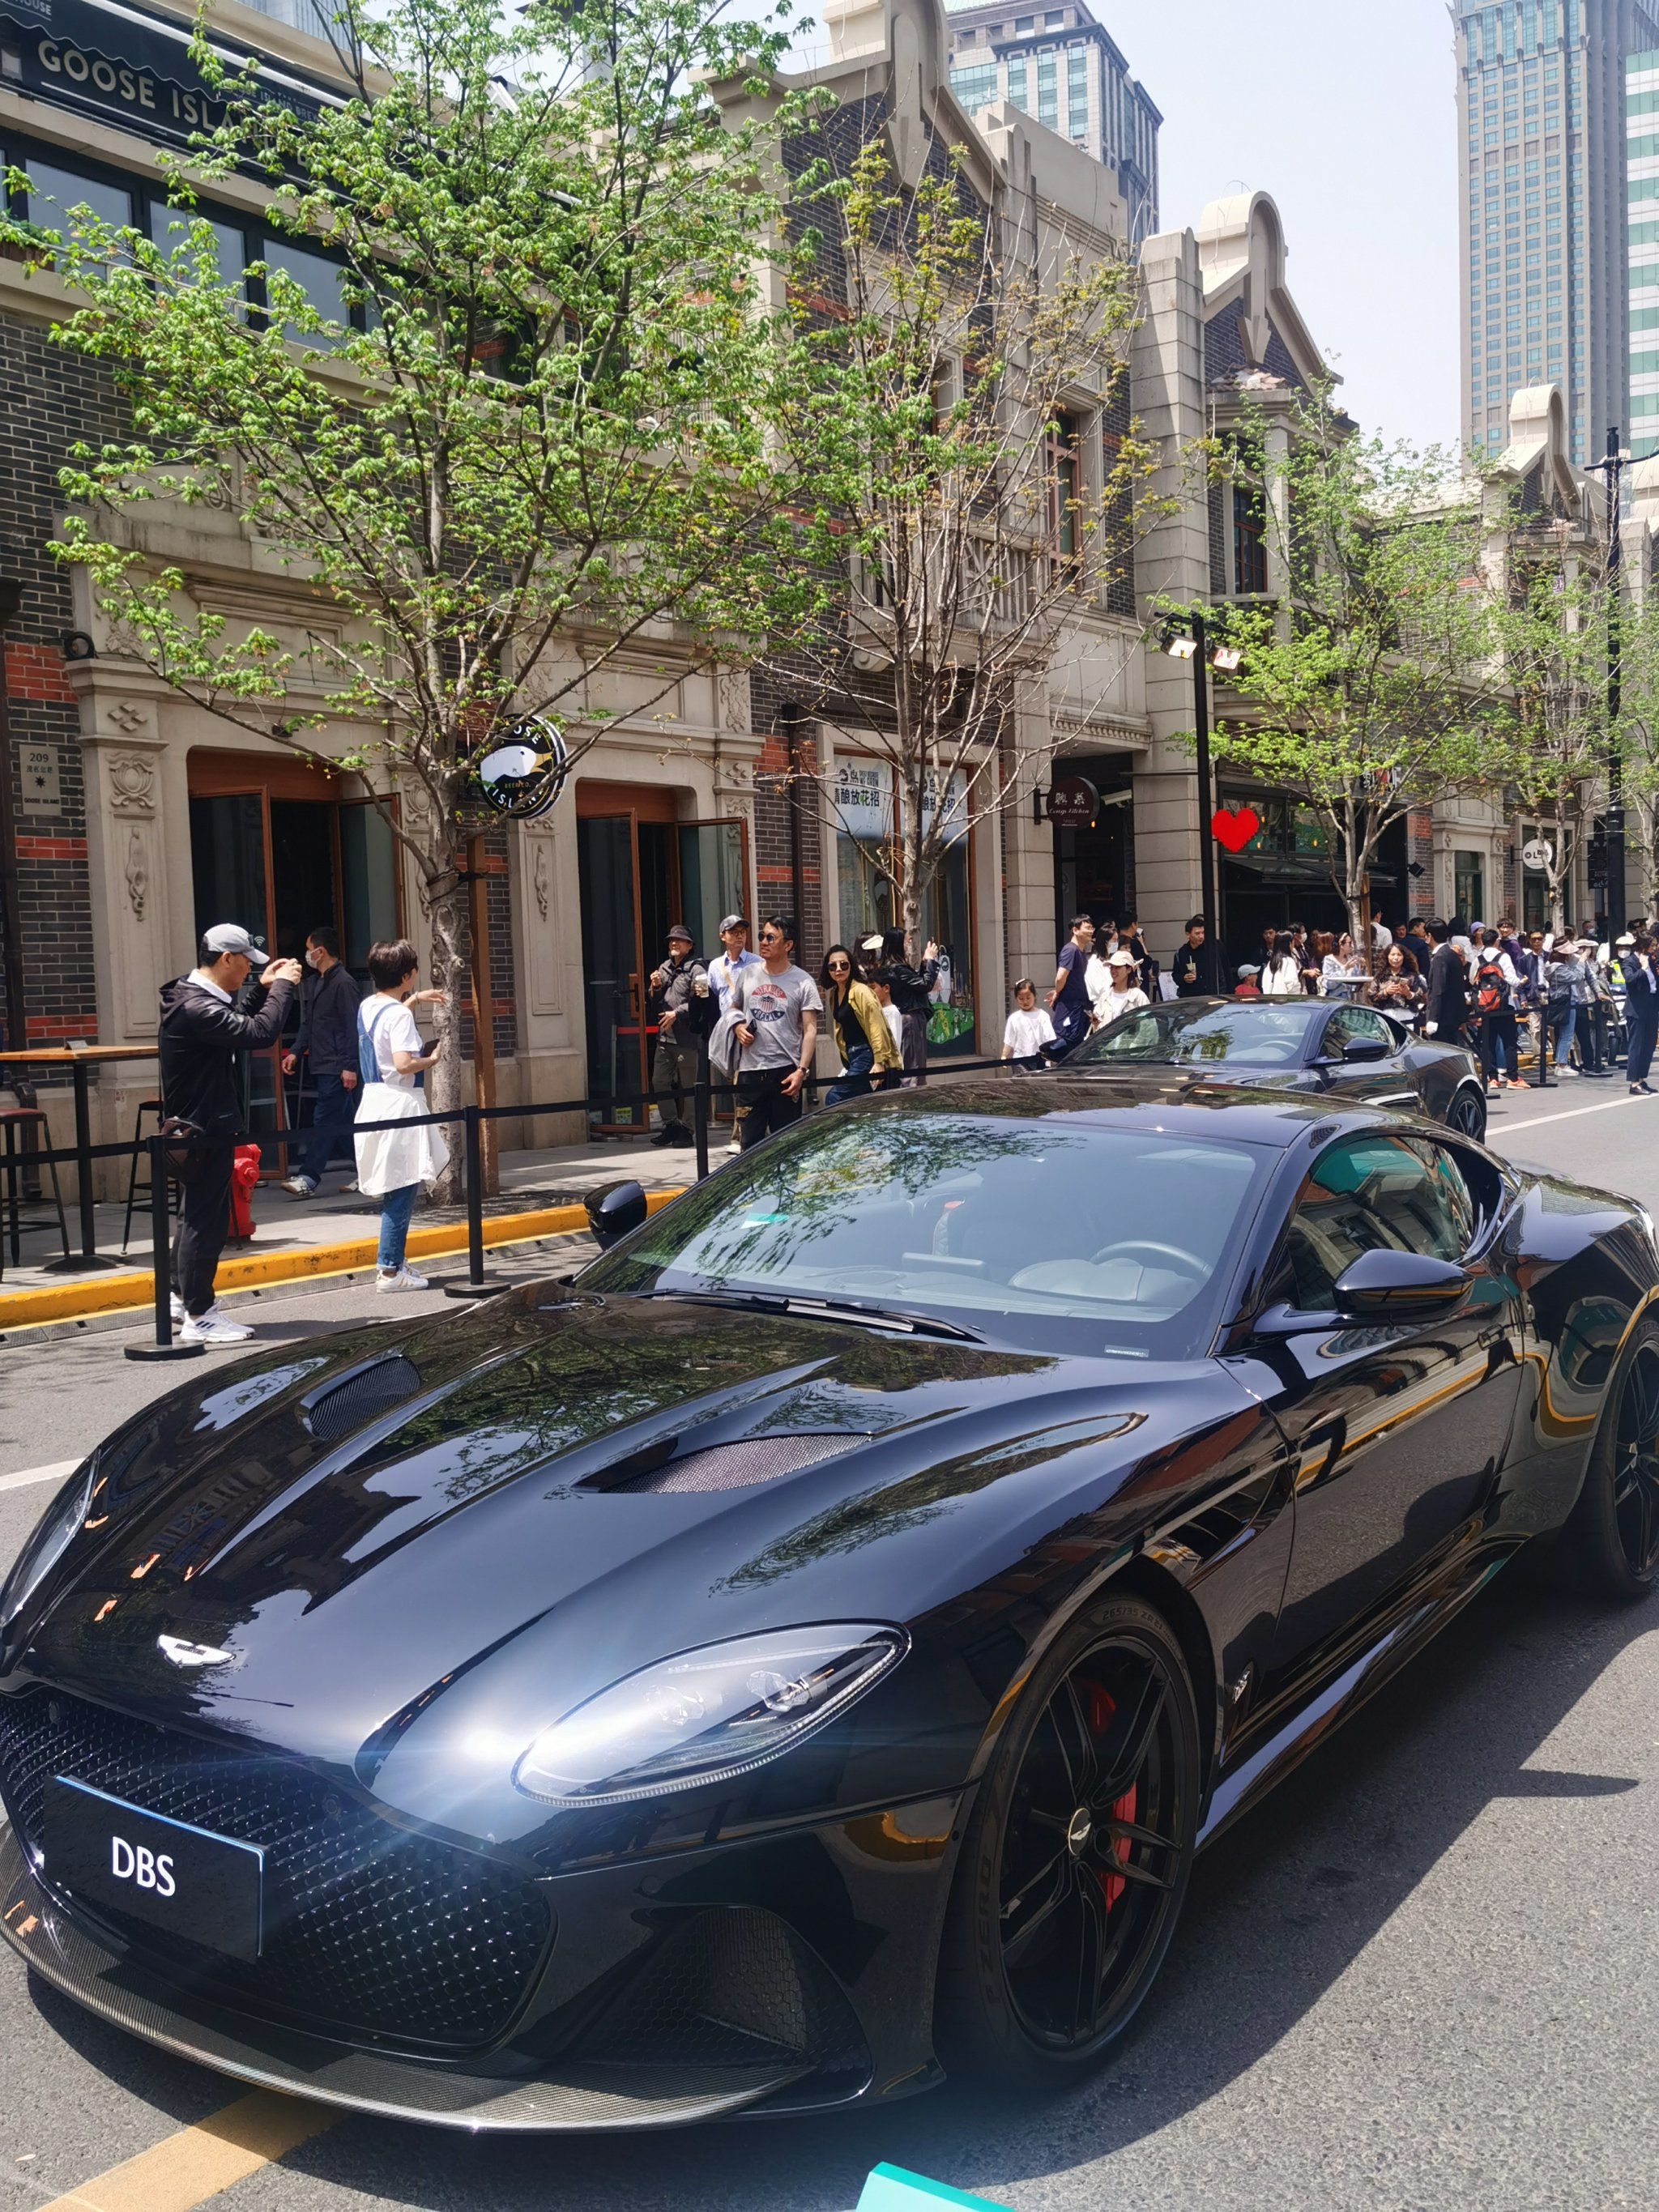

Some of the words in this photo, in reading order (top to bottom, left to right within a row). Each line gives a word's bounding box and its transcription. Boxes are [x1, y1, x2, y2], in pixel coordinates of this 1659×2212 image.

[16, 0, 52, 15] OUSE
[38, 40, 156, 109] GOOSE
[29, 752, 49, 763] 209
[112, 1835, 176, 1897] DBS
